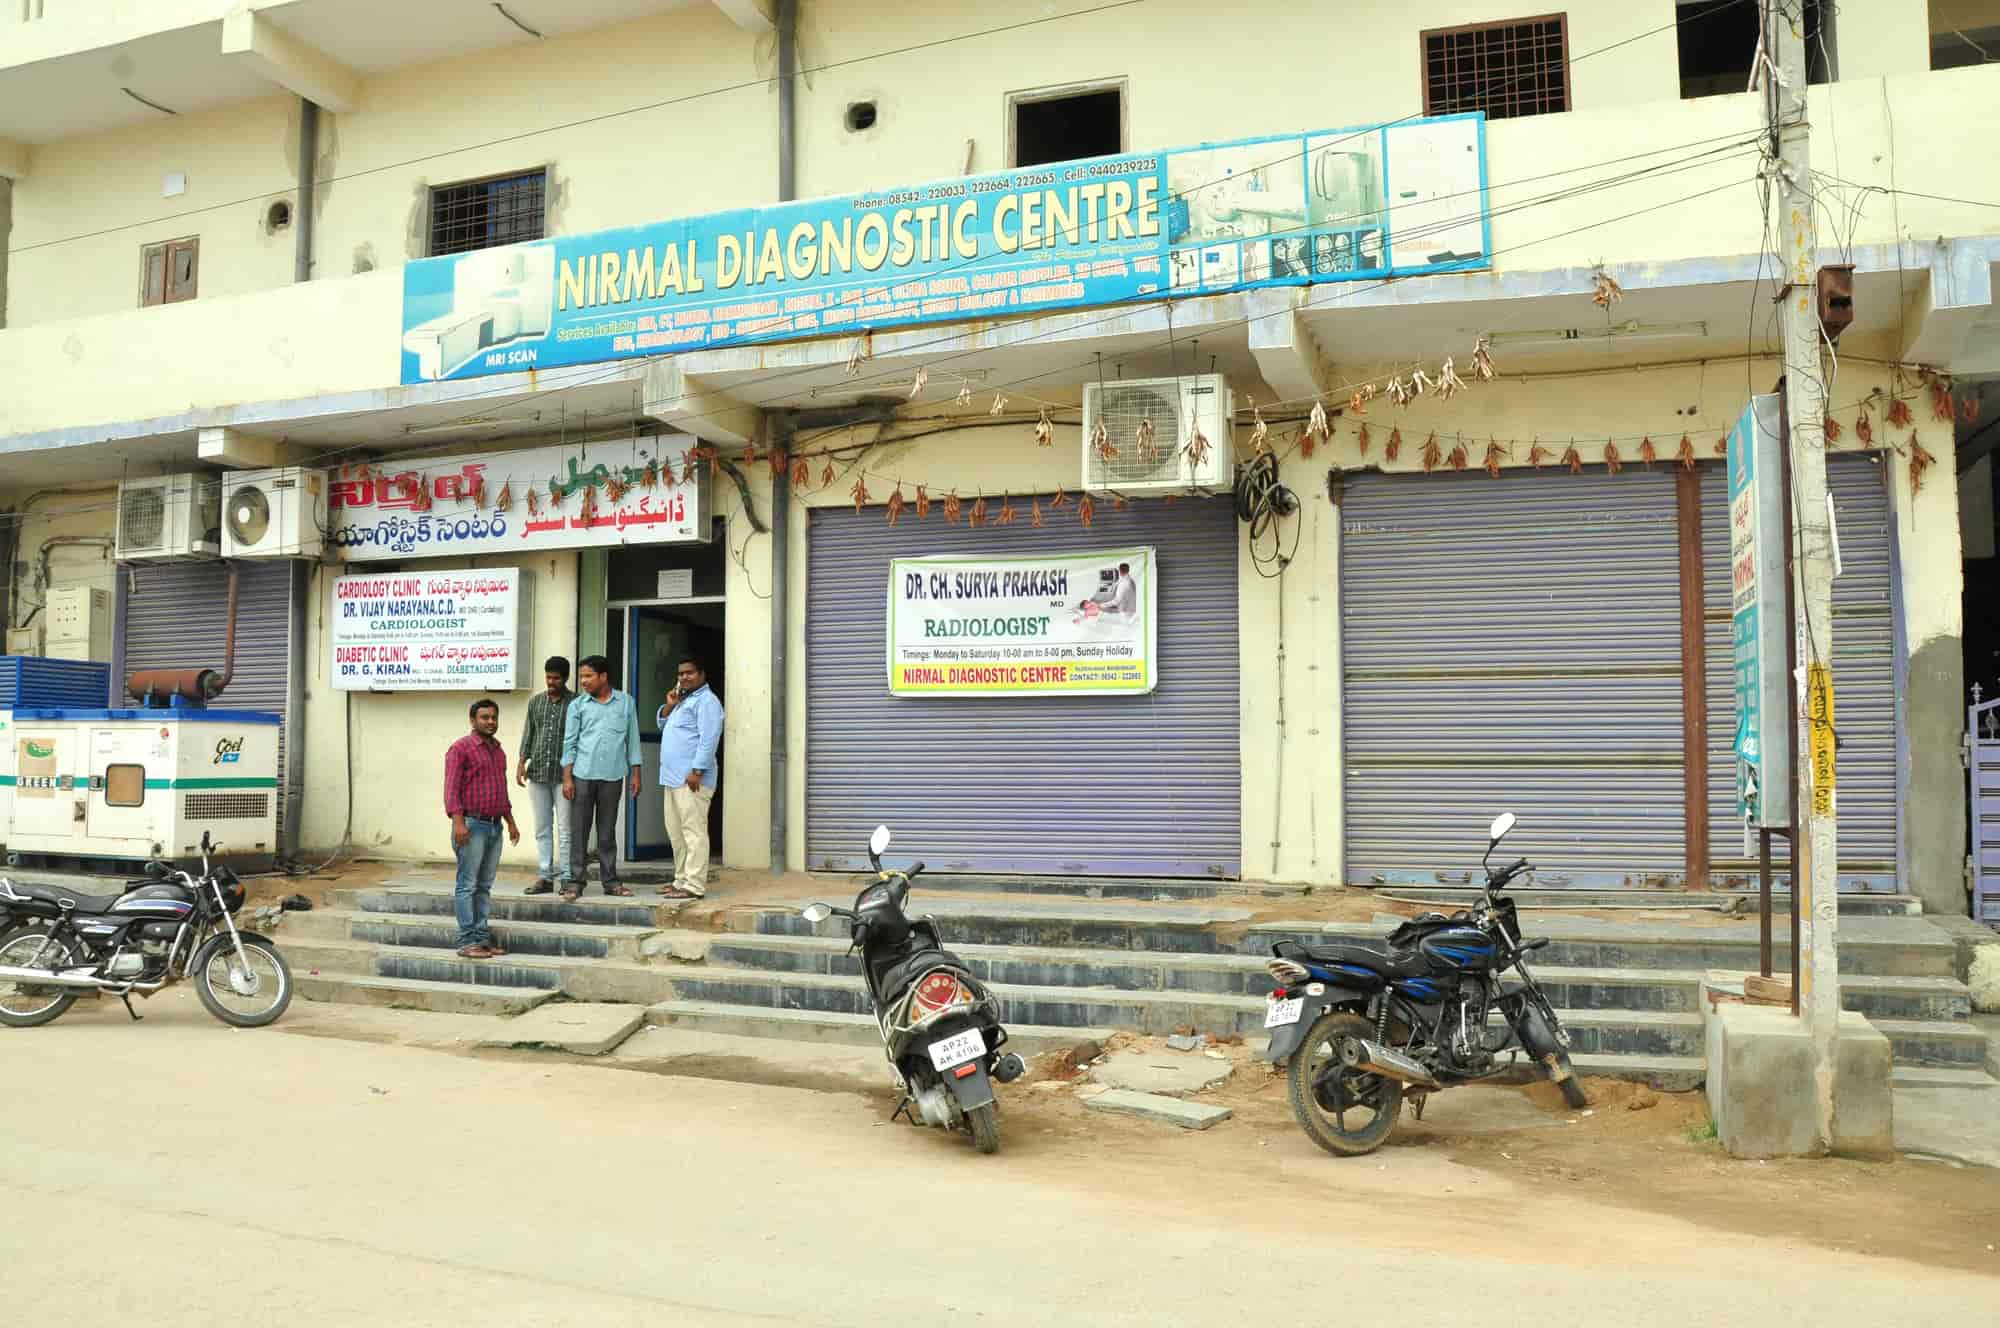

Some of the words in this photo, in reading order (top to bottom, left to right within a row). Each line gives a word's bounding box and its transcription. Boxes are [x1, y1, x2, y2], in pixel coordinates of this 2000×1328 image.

[853, 198, 886, 209] Phone:
[888, 191, 920, 205] 08542
[1064, 168, 1087, 181] Cell:
[1089, 158, 1157, 176] 9440239225
[559, 240, 704, 312] NIRMAL
[716, 199, 979, 290] DIAGNOSTIC
[992, 175, 1160, 254] CENTRE
[558, 326, 593, 341] Services
[486, 351, 506, 367] MRI
[508, 349, 537, 365] SCAN
[338, 580, 390, 599] CARDIOLOGY
[393, 578, 422, 597] CLINIC
[906, 573, 927, 600] DR.
[930, 573, 951, 599] CH.
[955, 571, 999, 599] SURYA
[1003, 569, 1068, 597] PRAKASH
[344, 602, 358, 618] DR.
[360, 600, 385, 617] VIJAY
[1050, 600, 1065, 608] MD
[370, 618, 467, 630] CARDIOLOGIST
[924, 616, 1051, 638] RADIOLOGIST
[336, 647, 376, 663] DIABETIC
[379, 645, 409, 663] CLINIC
[934, 648, 959, 661] Monday
[961, 649, 968, 658] to
[969, 648, 1000, 661] Saturday
[1035, 648, 1042, 657] to
[1077, 646, 1104, 659] Sunday
[1106, 644, 1134, 657] Holiday
[342, 664, 359, 675] DR.
[362, 664, 373, 675] G.
[376, 664, 411, 675] KIRAN
[904, 667, 945, 684] NIRMAL
[949, 666, 1017, 684] DIAGNOSTIC
[1021, 666, 1067, 683] CENTRE
